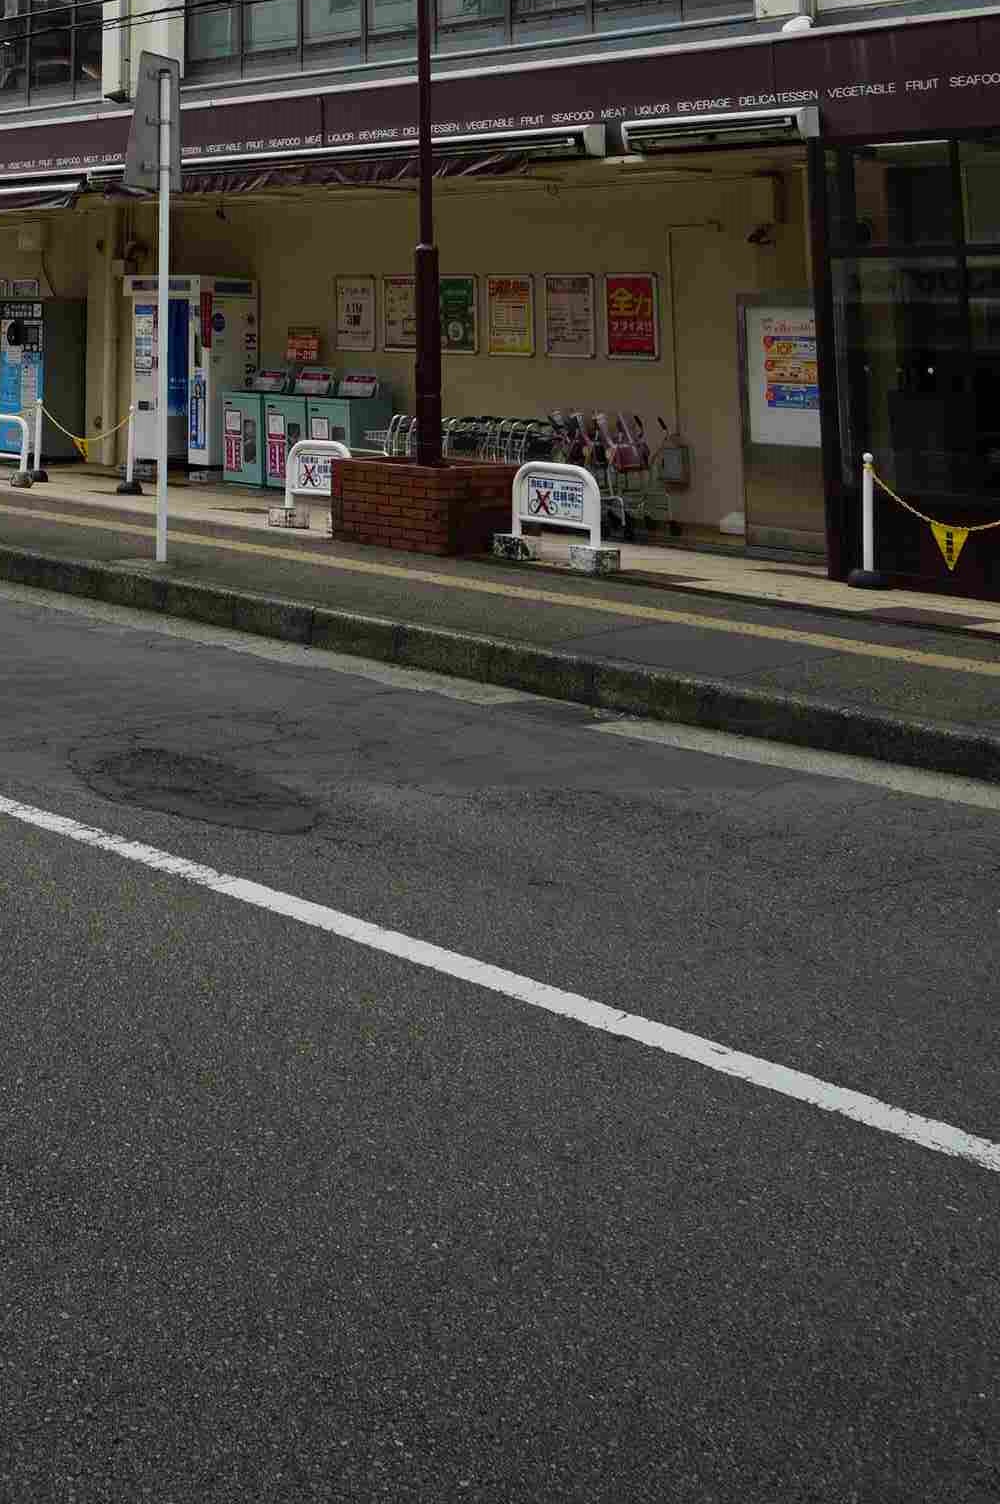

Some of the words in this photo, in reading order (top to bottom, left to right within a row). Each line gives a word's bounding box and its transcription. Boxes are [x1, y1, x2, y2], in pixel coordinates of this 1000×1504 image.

[327, 131, 354, 143] LIQUOR
[403, 121, 460, 137] DELITESSEN
[466, 117, 514, 131] VEGETABLE
[520, 114, 545, 126] FRUIT
[552, 110, 594, 124] SEAFOOD
[600, 107, 626, 119] MEAT
[634, 102, 670, 116] LIQUOR
[676, 96, 730, 113] BEVERAGE
[738, 89, 819, 107] DELICATESSEN
[827, 82, 896, 99] VEGETABLE
[905, 77, 939, 92] FRUIT
